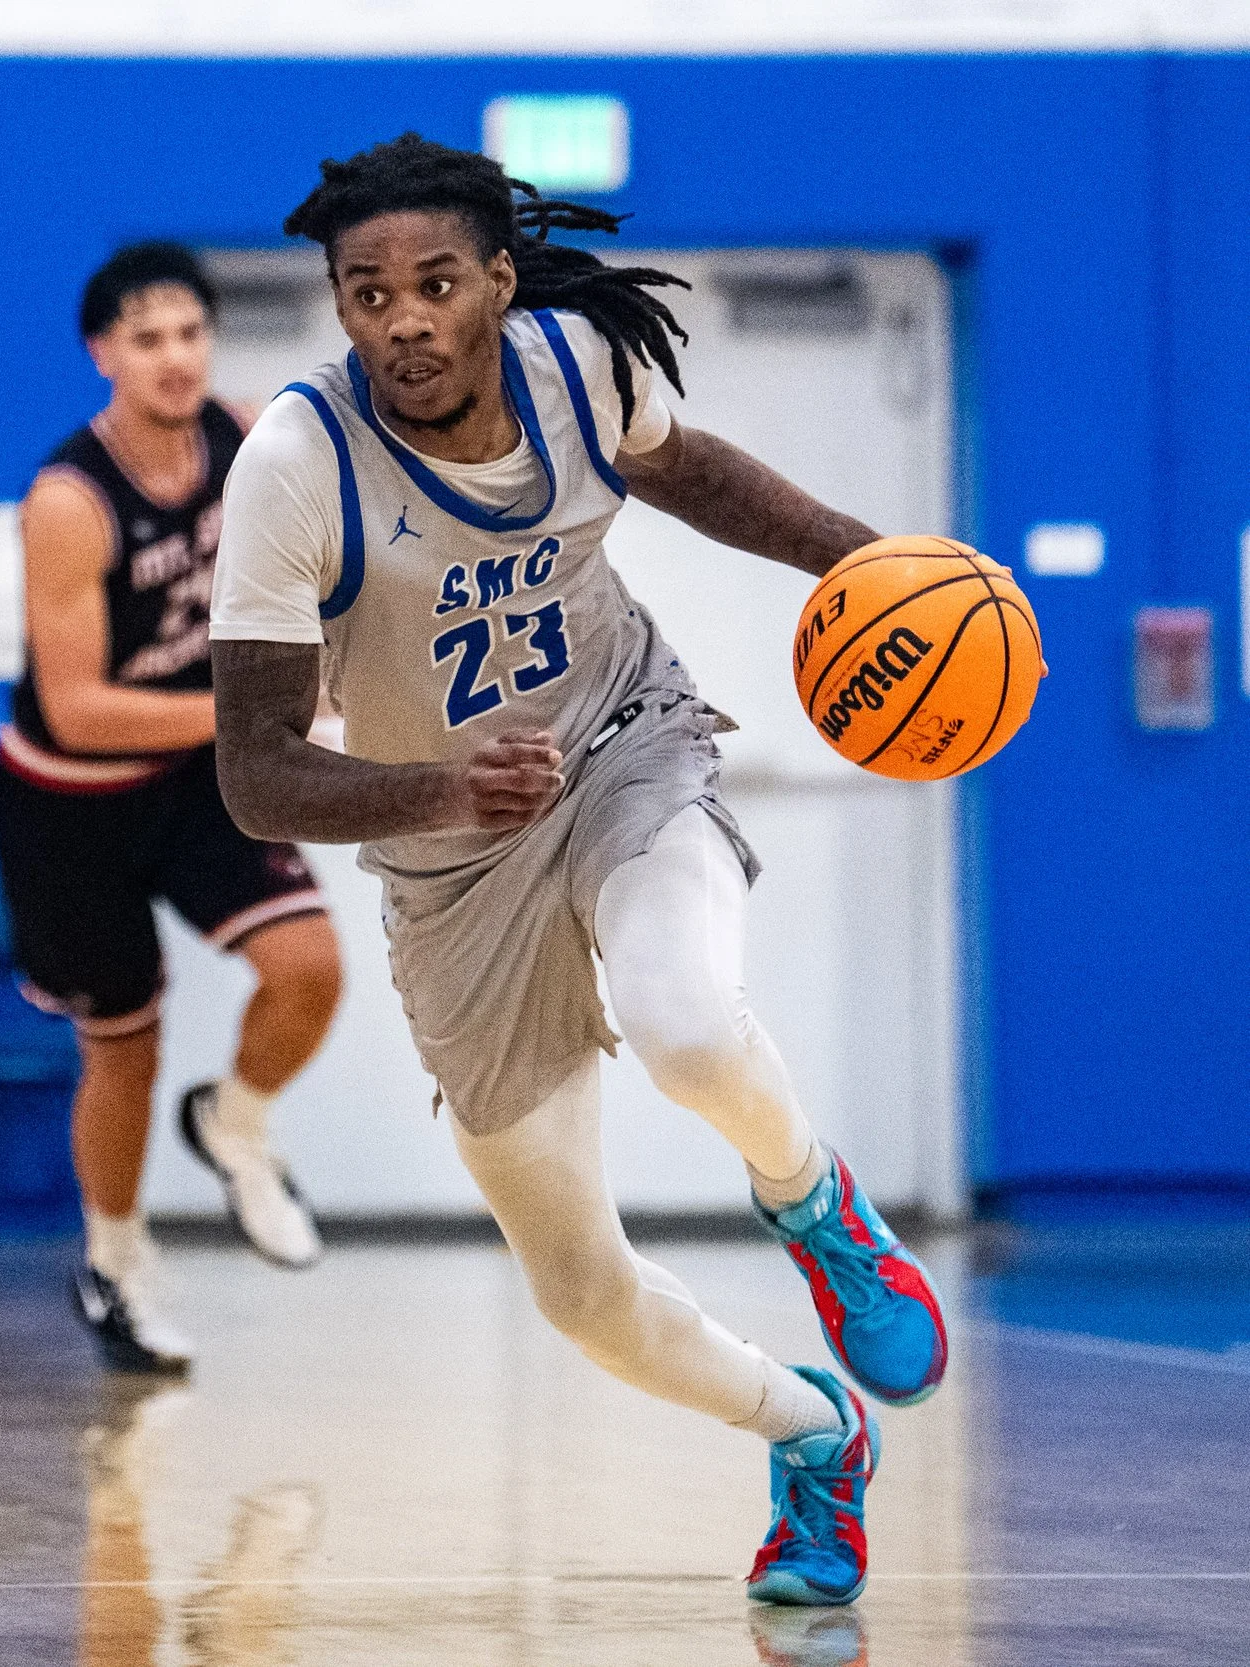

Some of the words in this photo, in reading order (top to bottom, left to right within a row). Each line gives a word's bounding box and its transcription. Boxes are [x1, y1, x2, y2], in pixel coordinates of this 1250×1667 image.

[433, 536, 563, 617] SMC
[431, 596, 572, 731] 23
[819, 627, 934, 741] Wilson
[920, 729, 958, 764] NFHS
